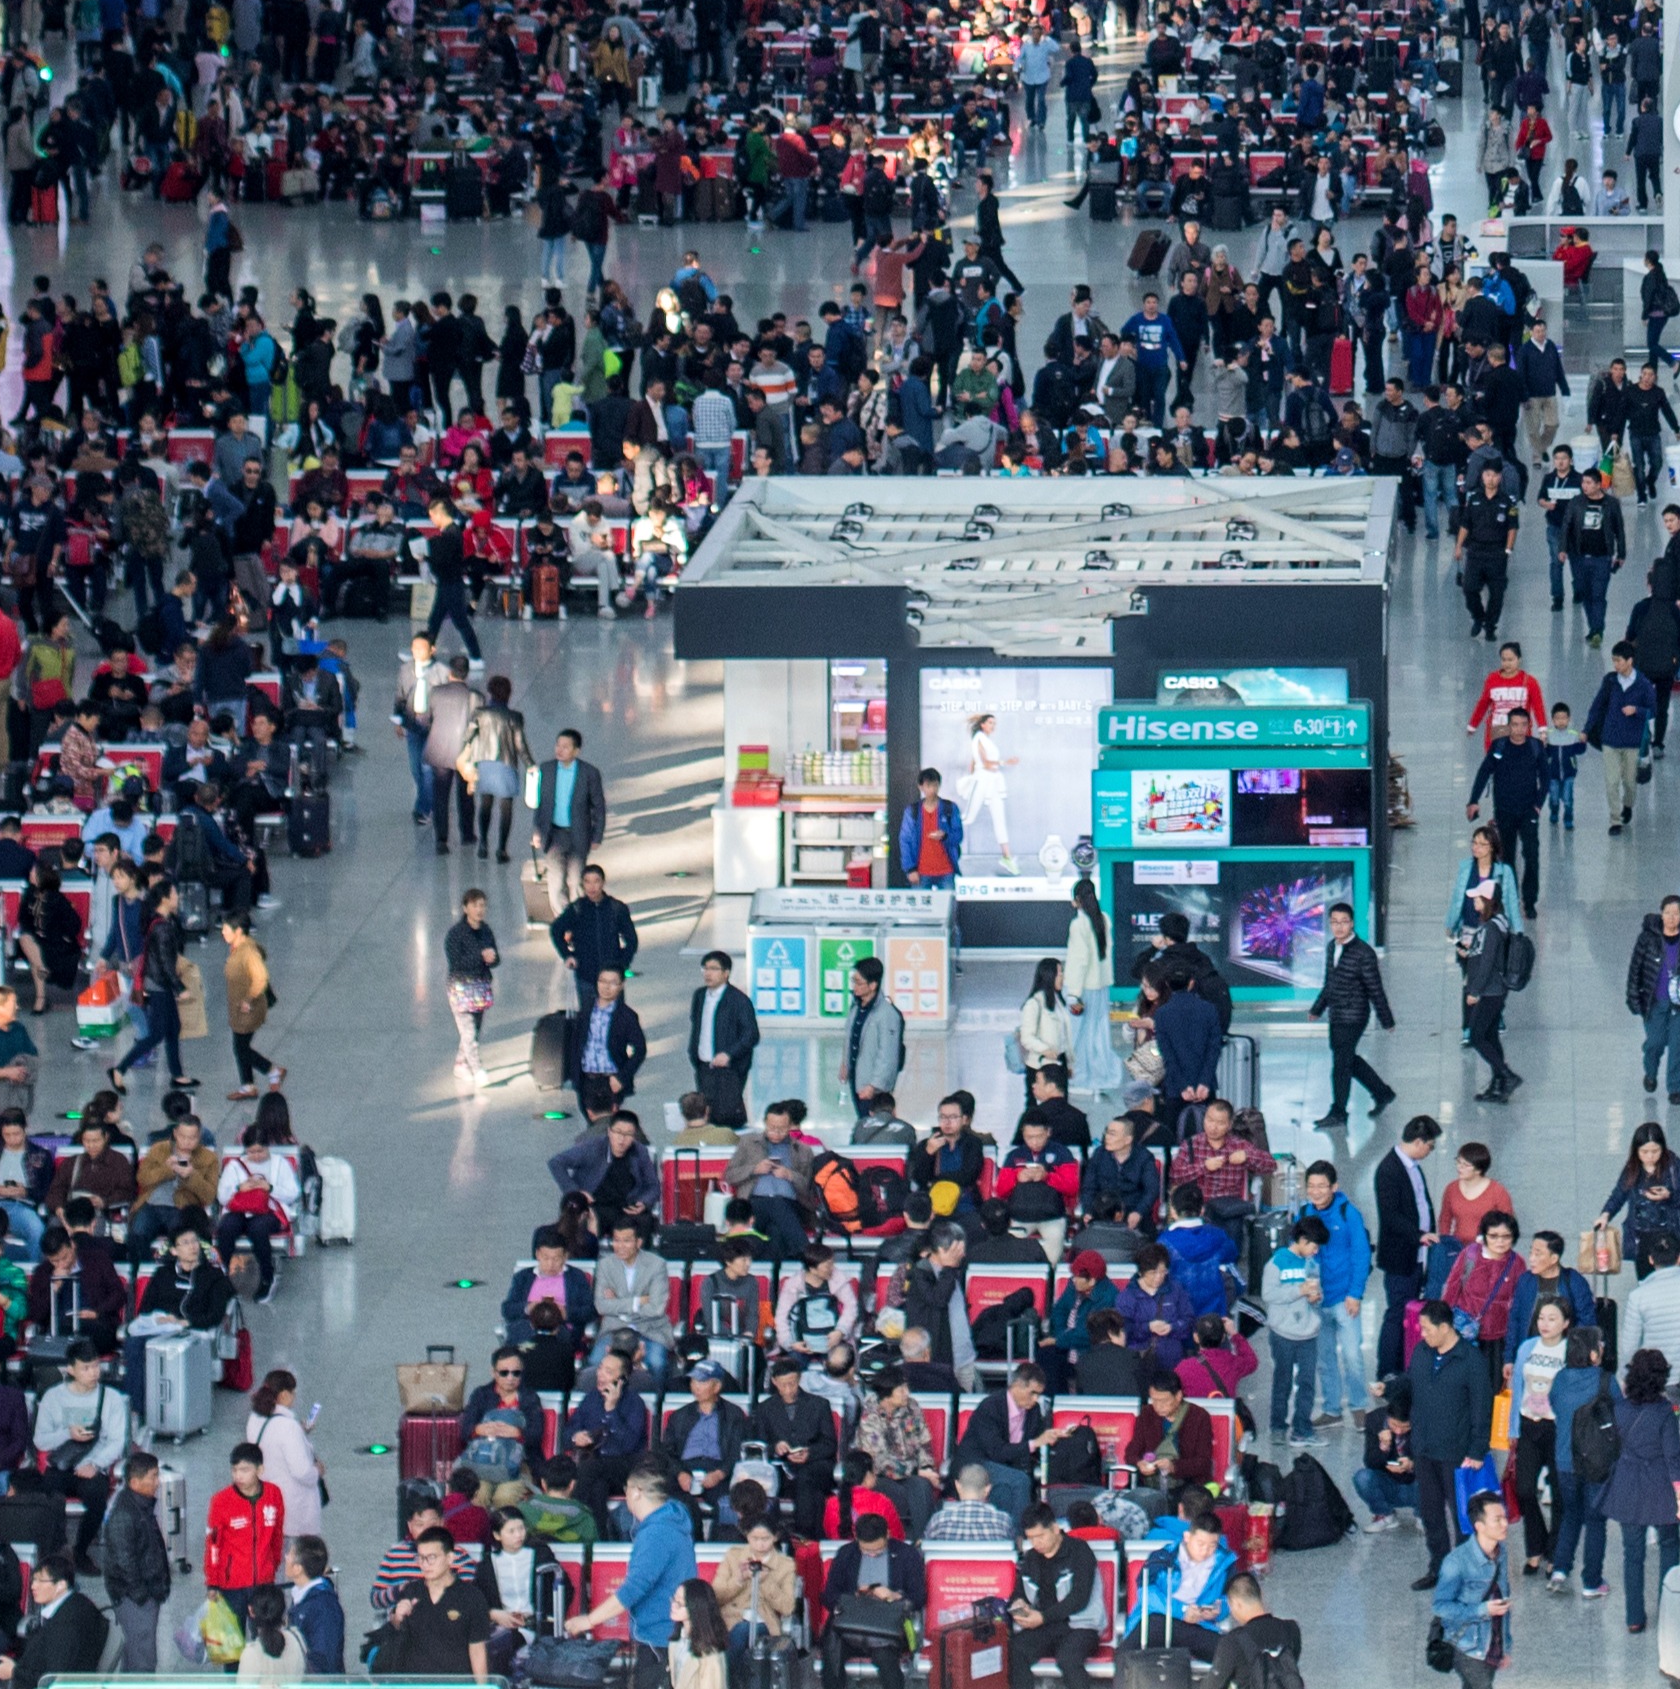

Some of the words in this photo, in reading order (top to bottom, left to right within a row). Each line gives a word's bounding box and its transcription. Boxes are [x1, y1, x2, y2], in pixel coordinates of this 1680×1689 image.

[928, 677, 982, 690] CASIO
[1164, 676, 1219, 689] CASIO
[941, 700, 963, 711] STEP
[965, 700, 982, 711] OUT
[1000, 700, 1022, 711] STEP
[1024, 700, 1037, 711] UP
[1058, 700, 1093, 711] BABY-G
[1107, 715, 1259, 740] Hisense
[1293, 719, 1322, 735] 6-30
